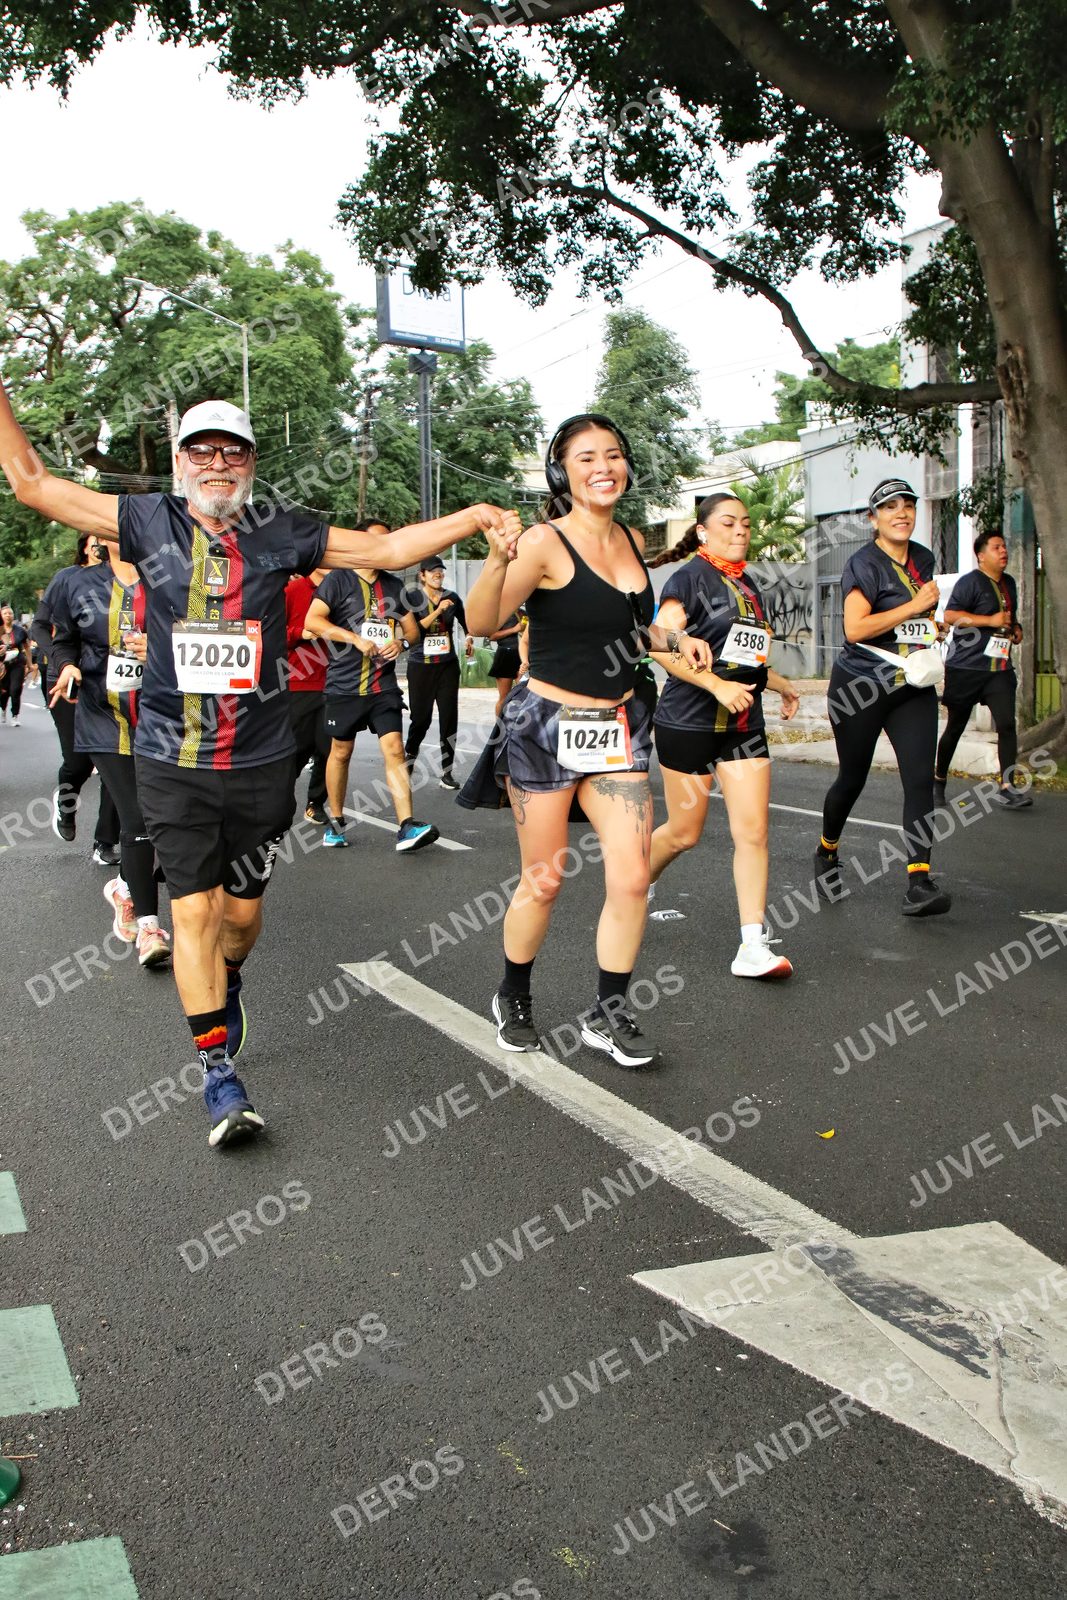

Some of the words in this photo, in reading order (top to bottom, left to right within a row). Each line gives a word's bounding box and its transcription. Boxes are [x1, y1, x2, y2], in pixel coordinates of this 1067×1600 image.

[367, 627, 389, 639] 6346
[901, 623, 930, 635] 3972
[427, 639, 446, 647] 2304
[733, 631, 765, 651] 4388
[177, 643, 251, 668] 12020
[563, 728, 619, 750] 10241
